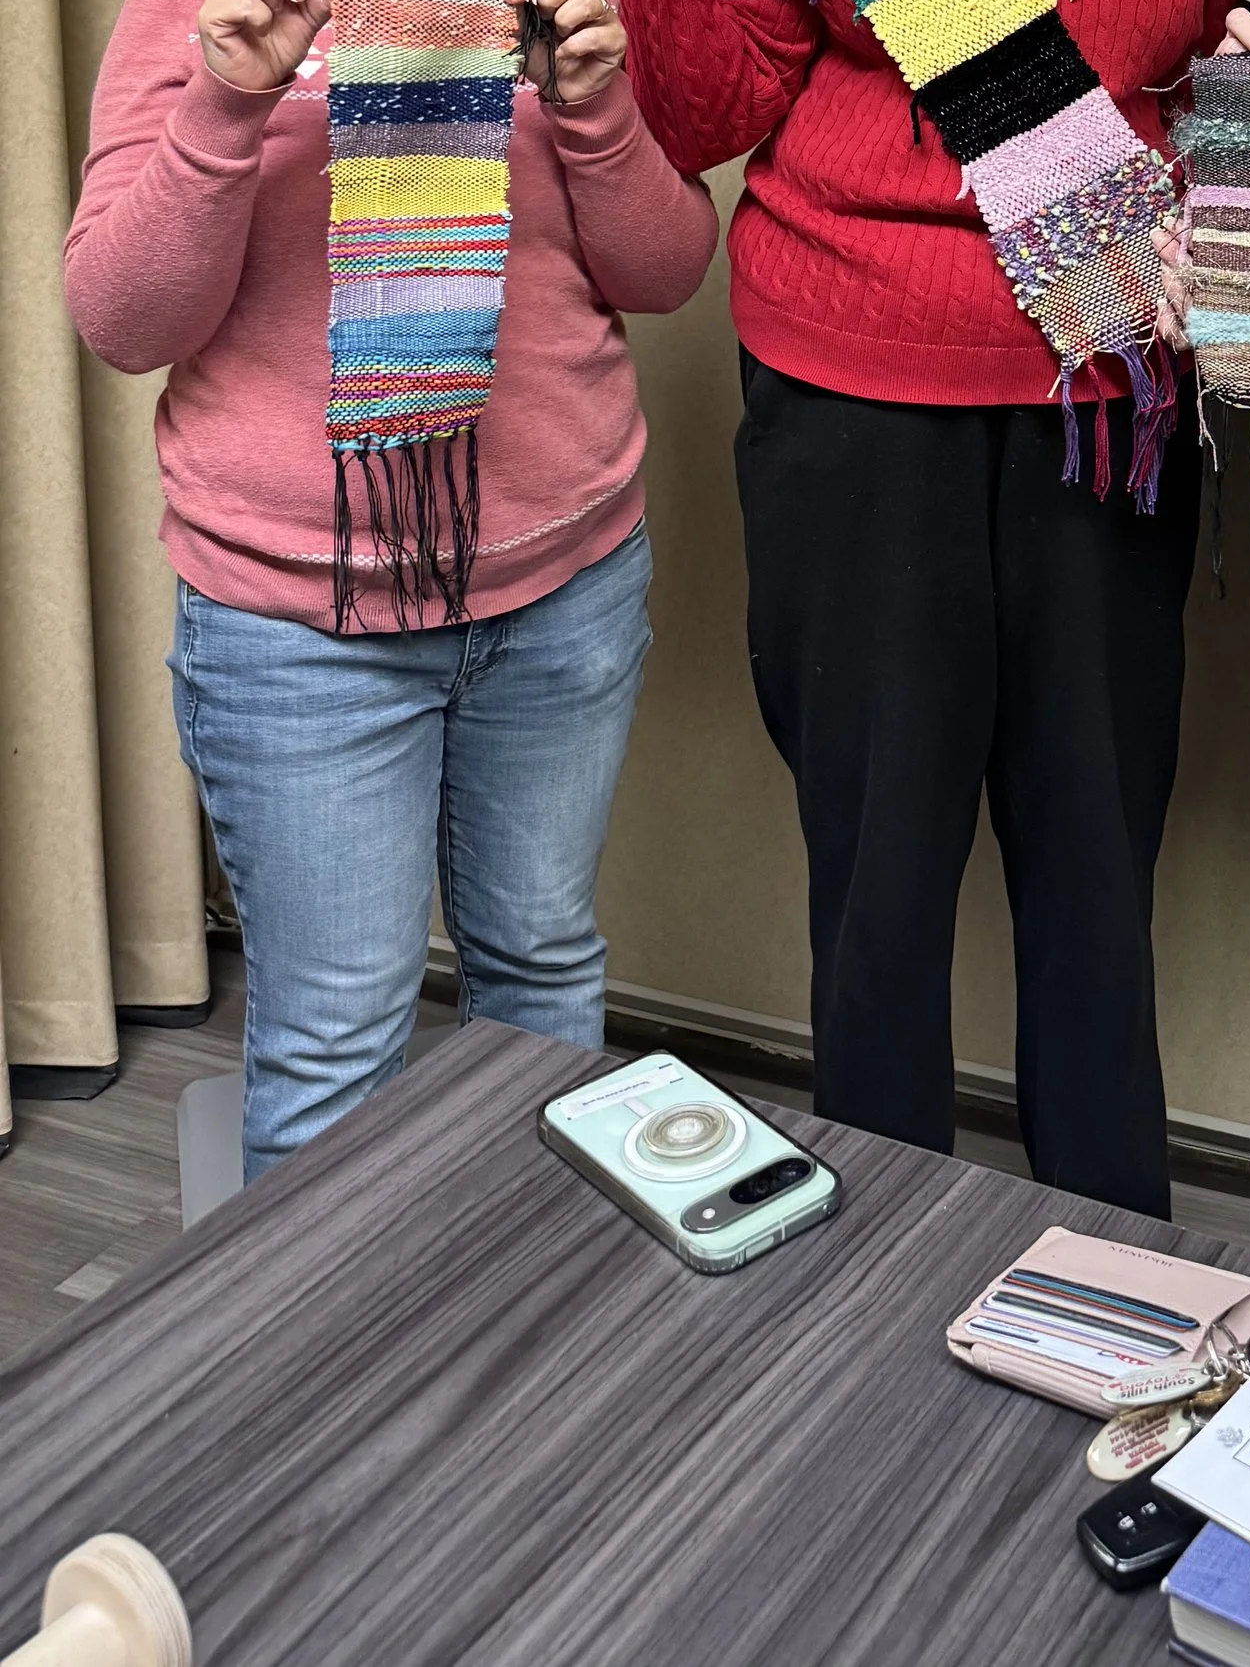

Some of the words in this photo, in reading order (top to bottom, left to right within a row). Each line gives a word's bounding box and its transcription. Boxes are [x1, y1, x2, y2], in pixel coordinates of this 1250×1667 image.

[1120, 1376, 1168, 1391] Toyota
[1154, 1377, 1195, 1390] South
[1120, 1387, 1148, 1398] Hills
